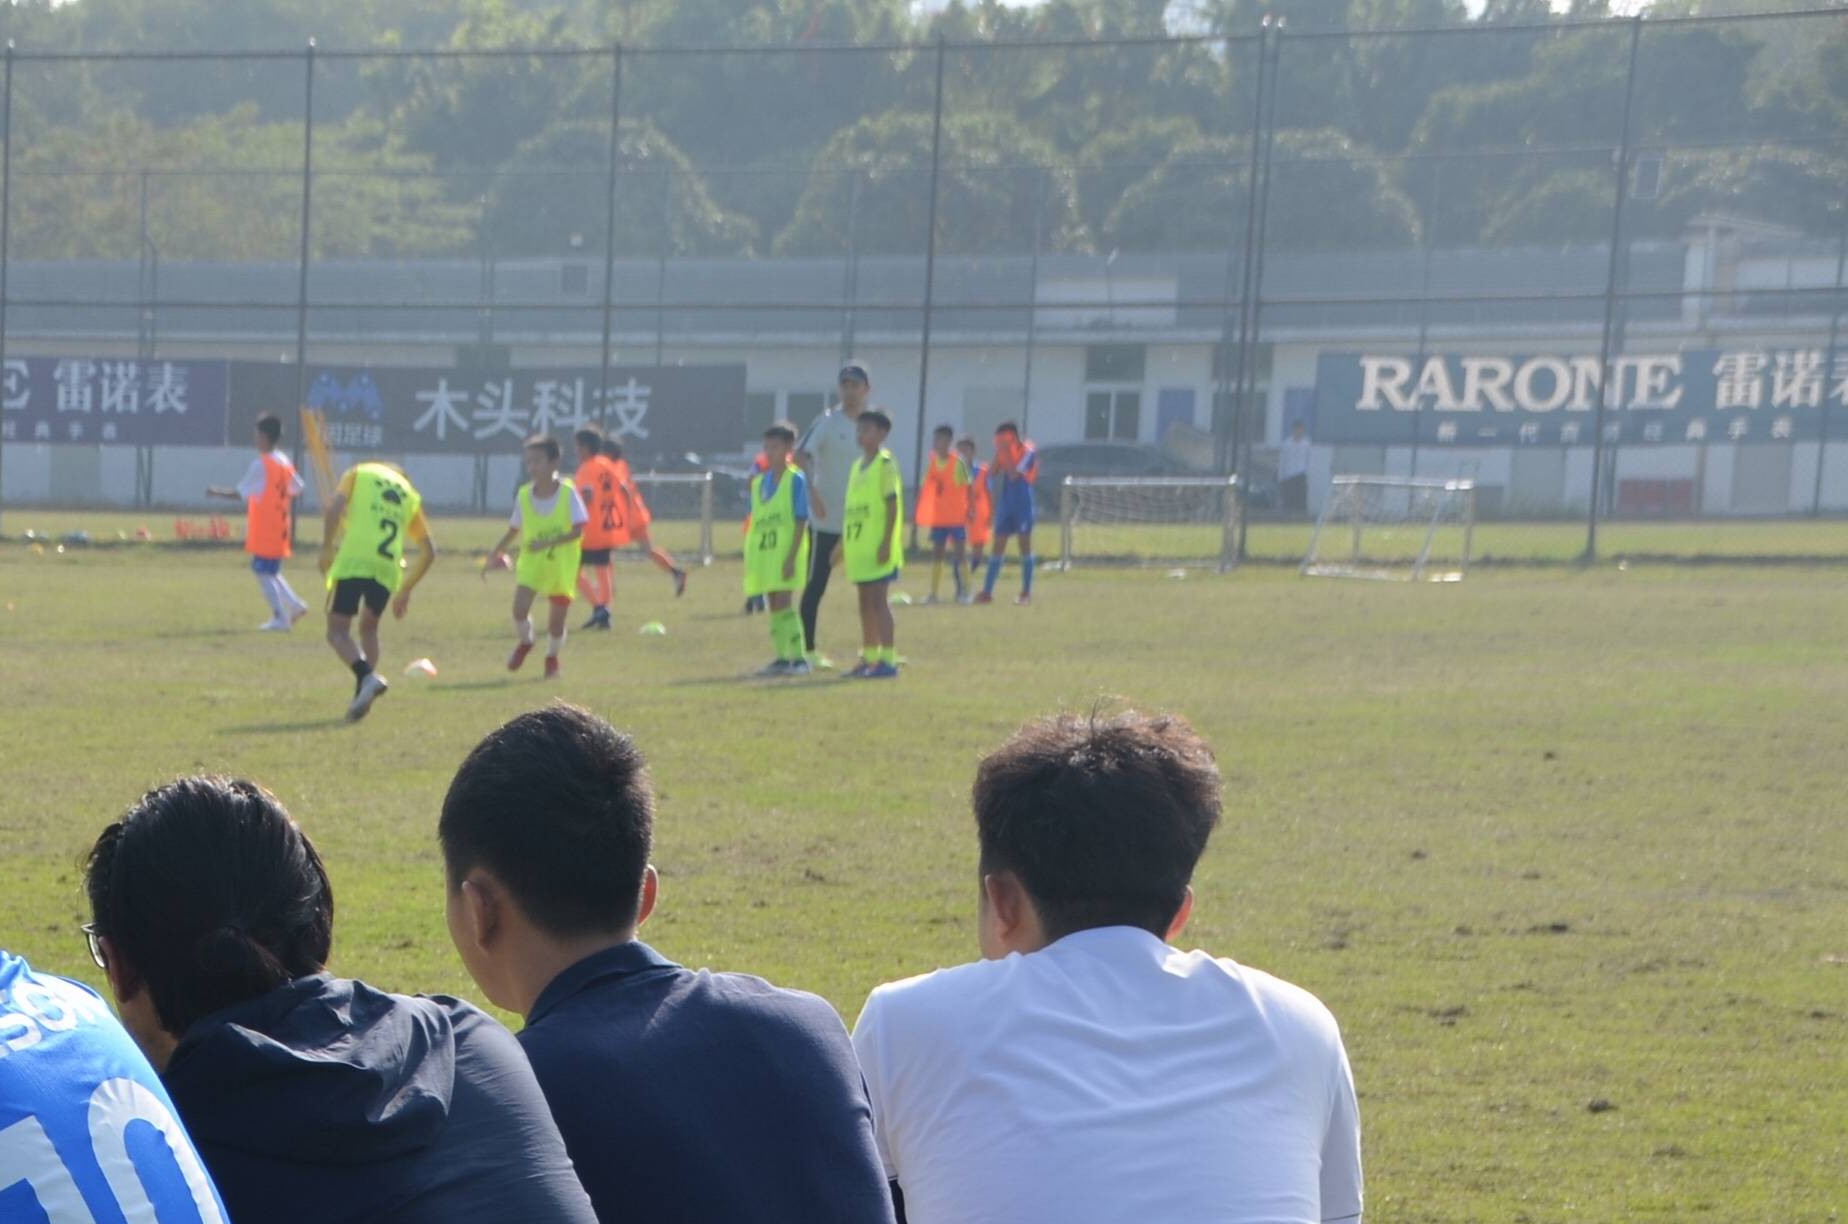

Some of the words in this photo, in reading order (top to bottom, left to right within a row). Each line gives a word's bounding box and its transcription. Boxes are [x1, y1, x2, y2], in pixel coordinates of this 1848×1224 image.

[53, 359, 189, 415] 雷诺表
[413, 377, 652, 440] 木头科技
[1355, 354, 1684, 412] RARONE
[377, 518, 399, 560] 2
